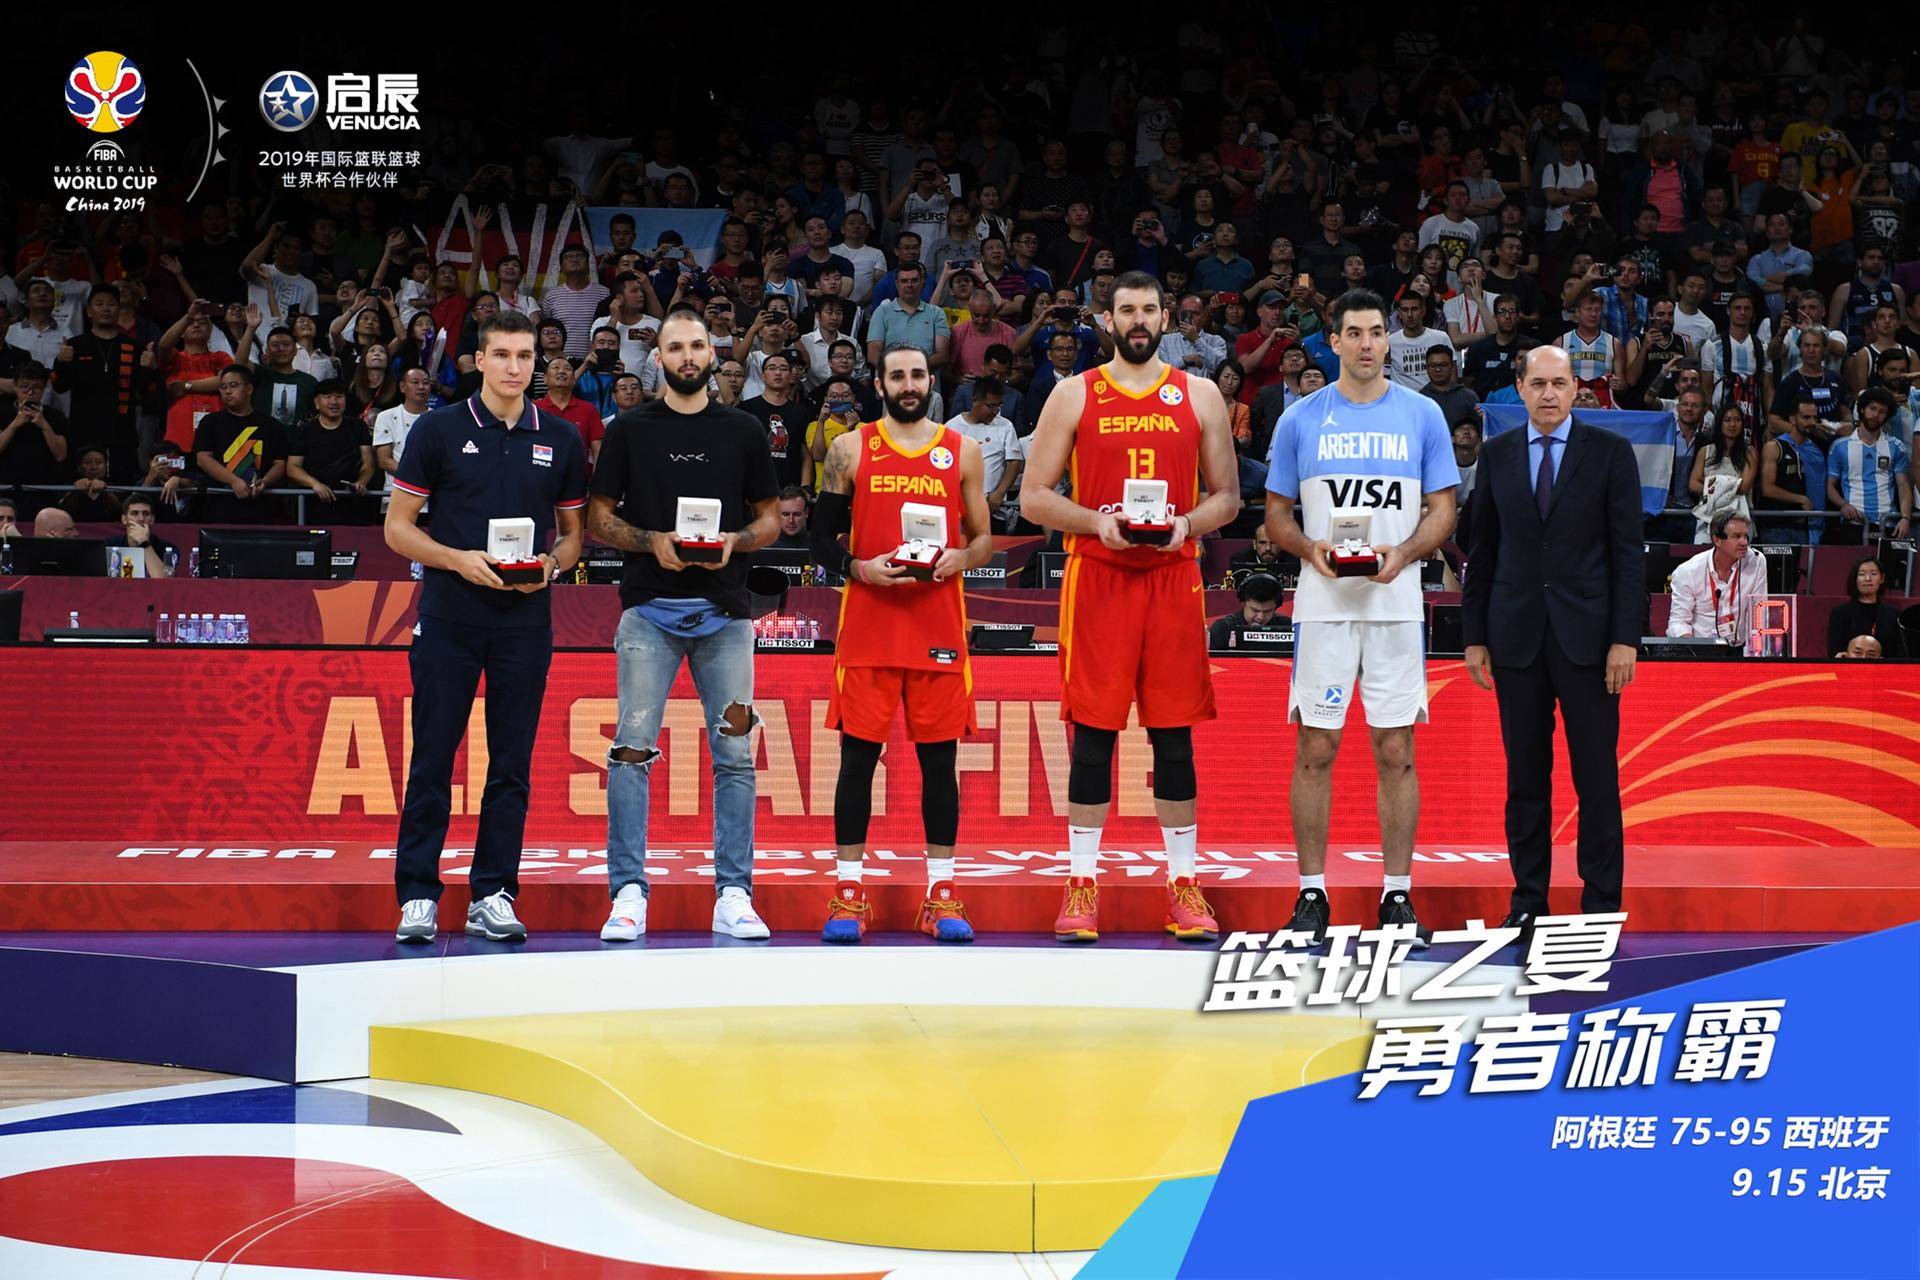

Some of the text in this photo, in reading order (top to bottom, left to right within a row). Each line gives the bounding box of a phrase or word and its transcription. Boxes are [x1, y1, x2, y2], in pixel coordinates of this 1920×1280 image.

[1099, 413, 1180, 434] ESPAÑA
[1318, 432, 1409, 462] ARGENTINA
[1127, 448, 1155, 479] 13
[870, 475, 947, 498] ESPAÑA
[1321, 479, 1402, 511] VISA
[775, 639, 813, 647] TISSOT
[116, 848, 337, 859] FIBA
[1342, 851, 1510, 862] CUP
